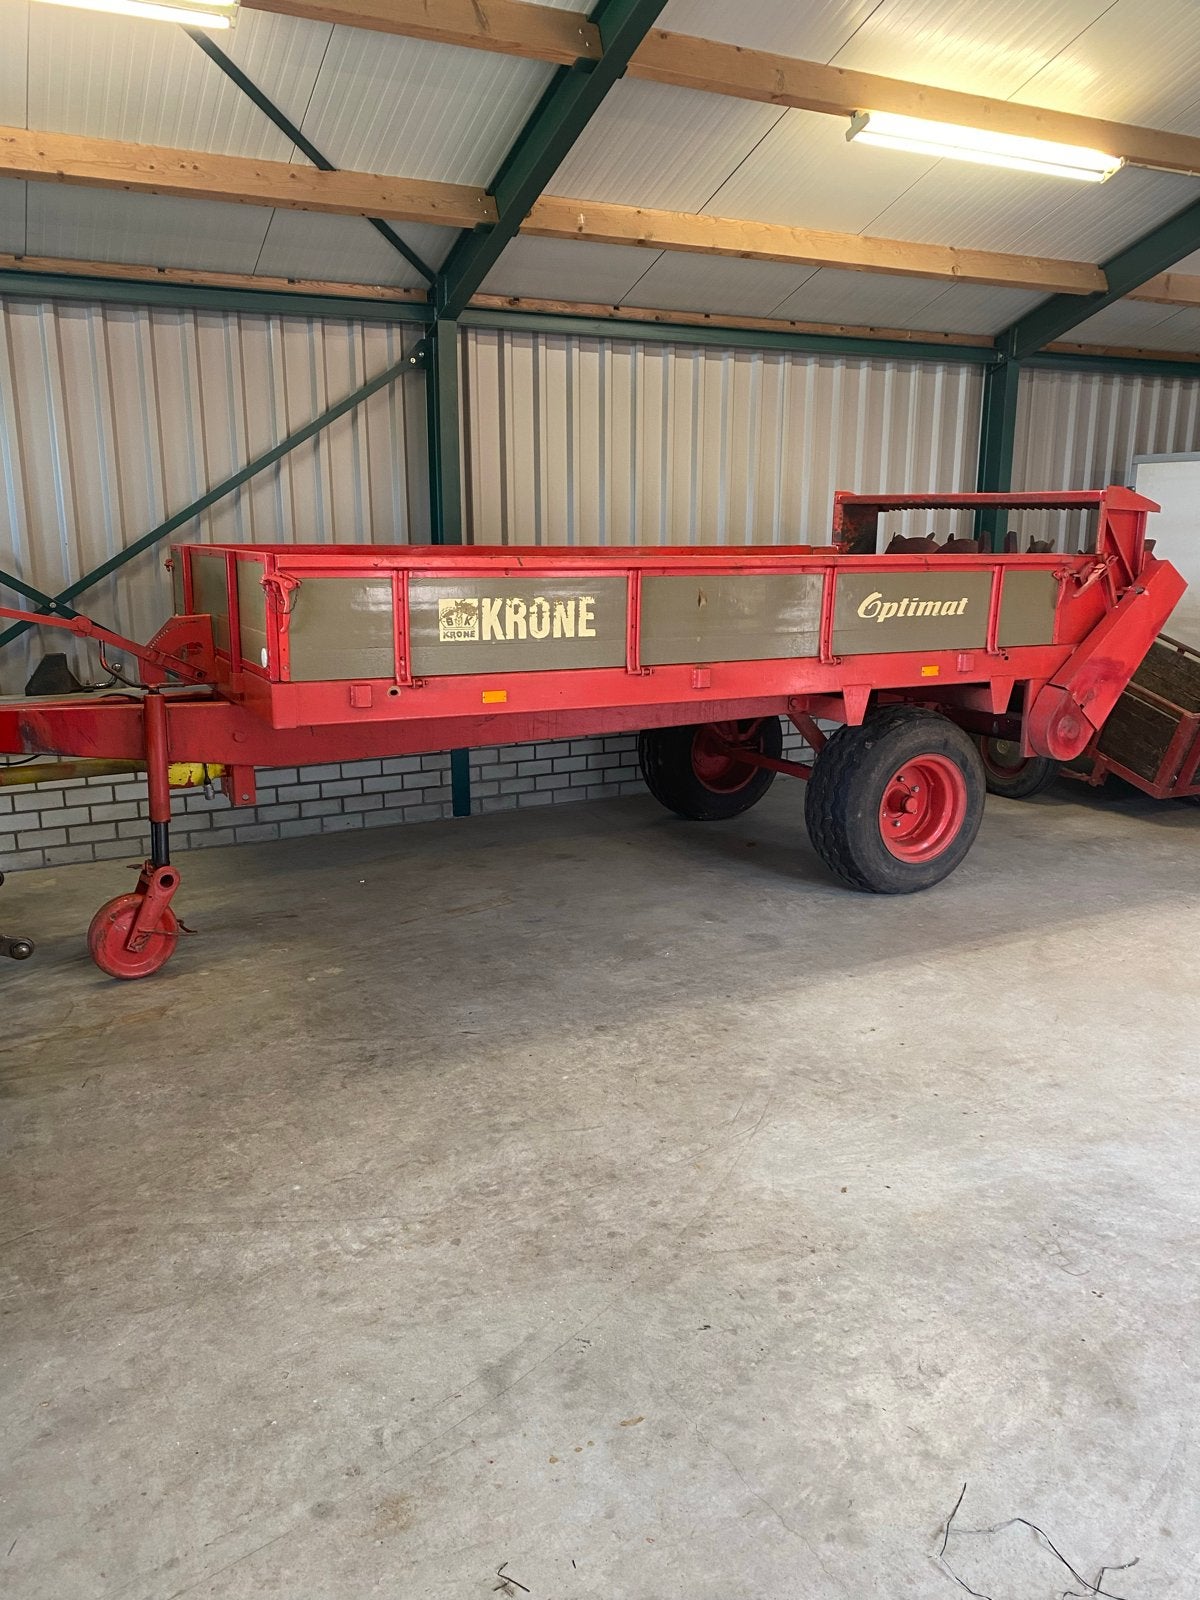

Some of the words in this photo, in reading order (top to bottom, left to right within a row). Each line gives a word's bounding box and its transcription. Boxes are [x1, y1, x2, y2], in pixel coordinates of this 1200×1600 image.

[481, 596, 597, 641] KRONE
[857, 591, 969, 623] Optimat
[442, 630, 476, 640] KRONE
